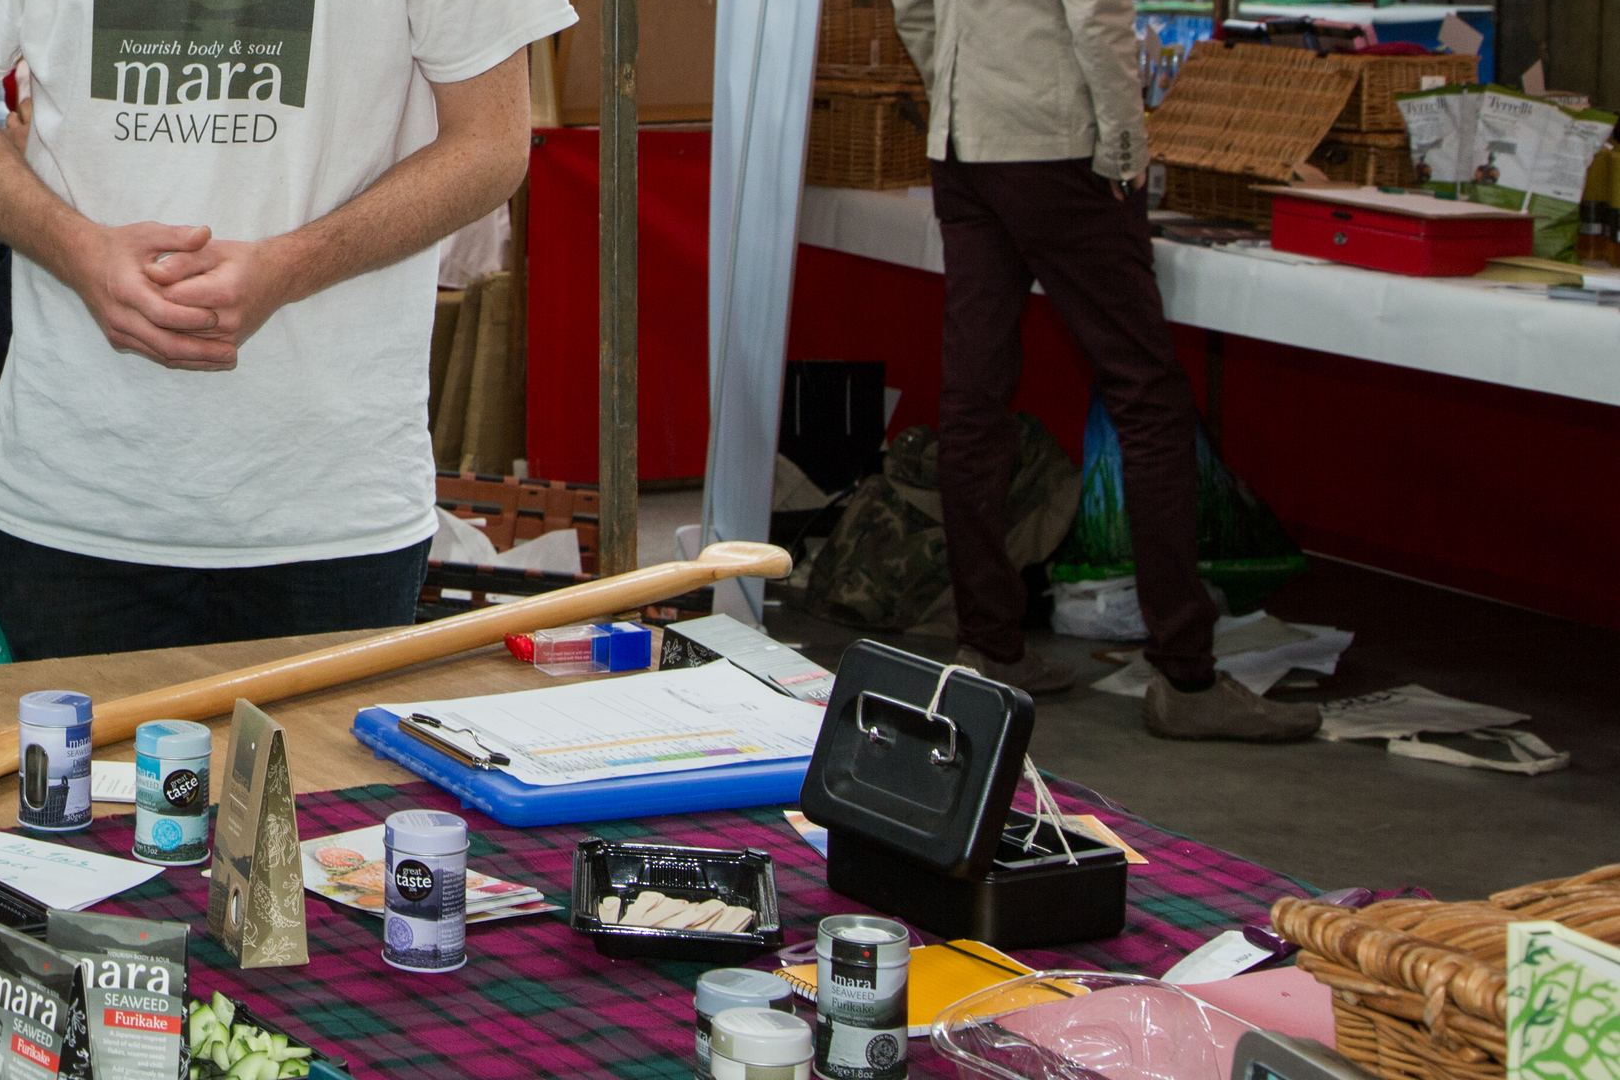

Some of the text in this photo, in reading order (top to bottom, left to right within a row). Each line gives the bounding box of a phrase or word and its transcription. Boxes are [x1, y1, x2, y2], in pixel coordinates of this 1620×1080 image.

[119, 39, 283, 58] Nourish body & soul
[114, 60, 282, 106] mara
[114, 111, 278, 144] SEAWEED
[166, 777, 198, 800] taste
[170, 774, 188, 789] great
[396, 873, 432, 888] taste
[402, 866, 422, 877] great
[108, 951, 133, 959] NOURISH
[834, 974, 872, 990] mara
[104, 992, 169, 1012] SEAWEED
[832, 985, 875, 1000] SEAWEED
[832, 996, 874, 1014] Furikake
[115, 1011, 168, 1030] Furikake
[12, 1017, 53, 1048] SEAWEED
[17, 1038, 51, 1066] Furikake
